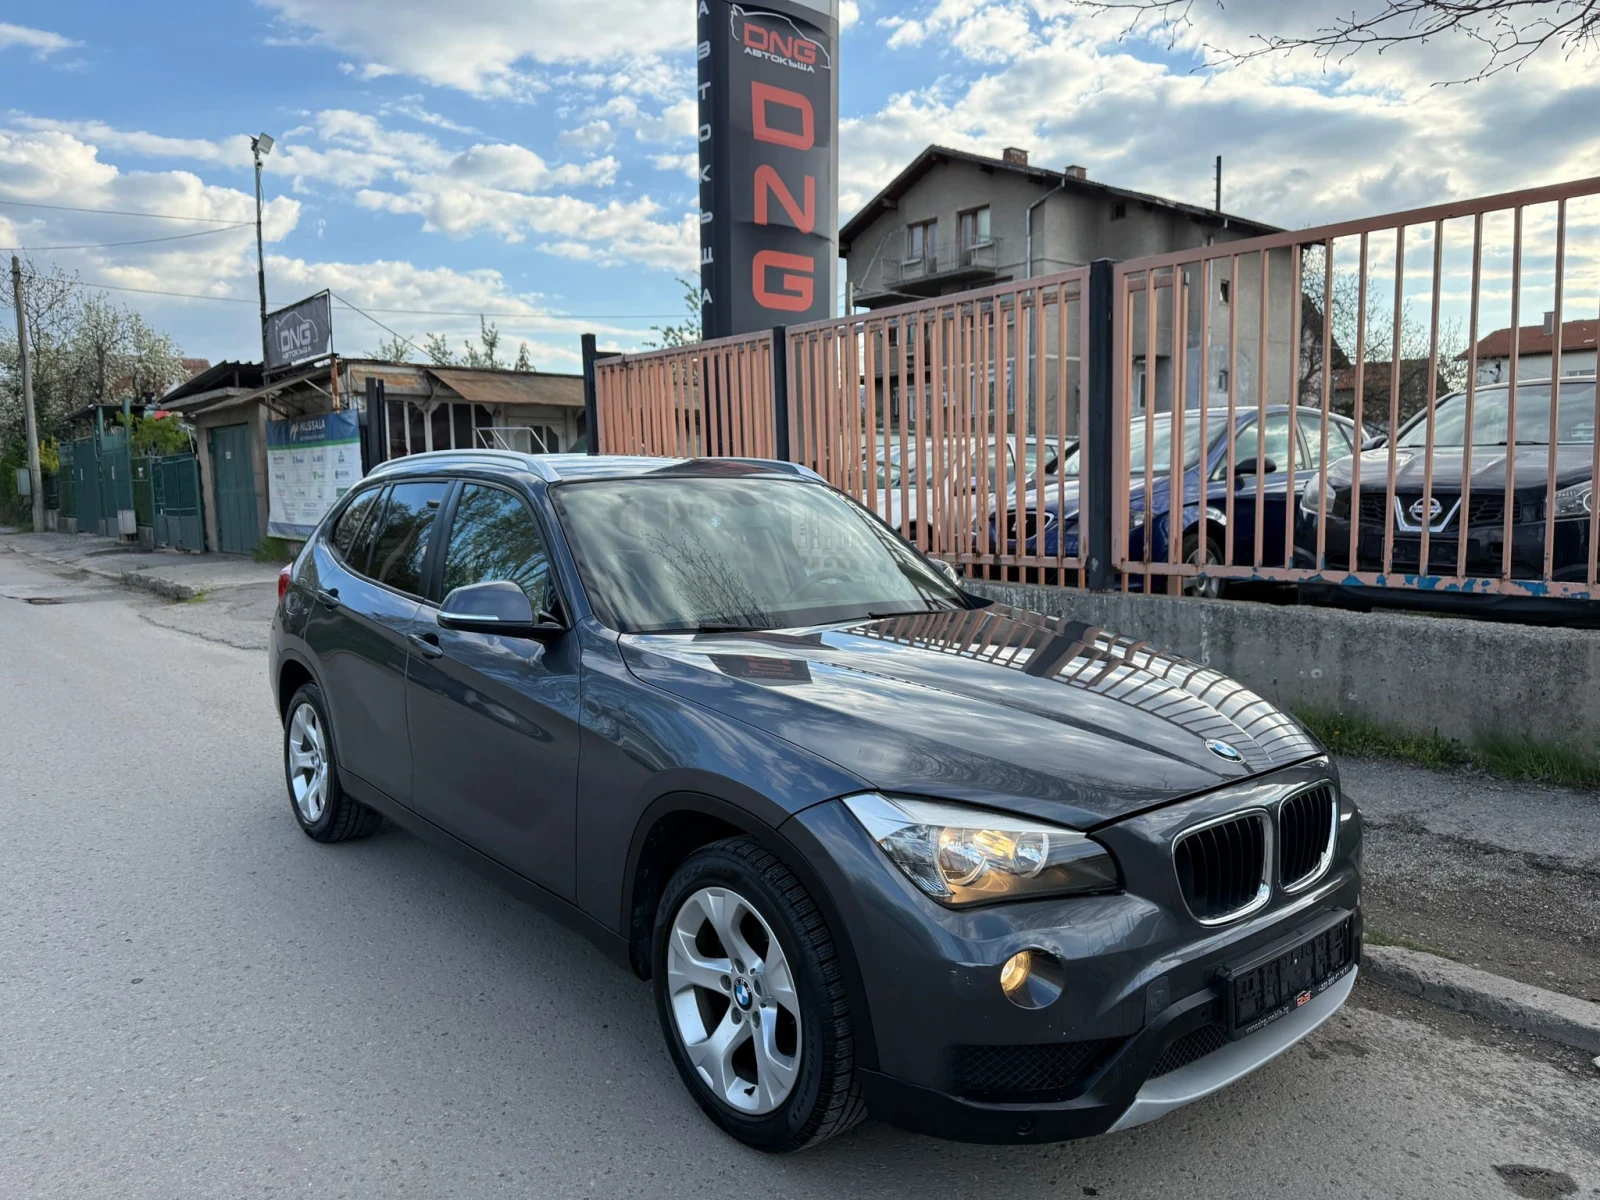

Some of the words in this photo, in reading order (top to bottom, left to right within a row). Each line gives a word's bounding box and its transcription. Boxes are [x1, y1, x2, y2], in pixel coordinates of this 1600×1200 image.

[743, 22, 817, 65] DNG
[751, 80, 815, 312] DNG
[280, 322, 311, 352] DNG
